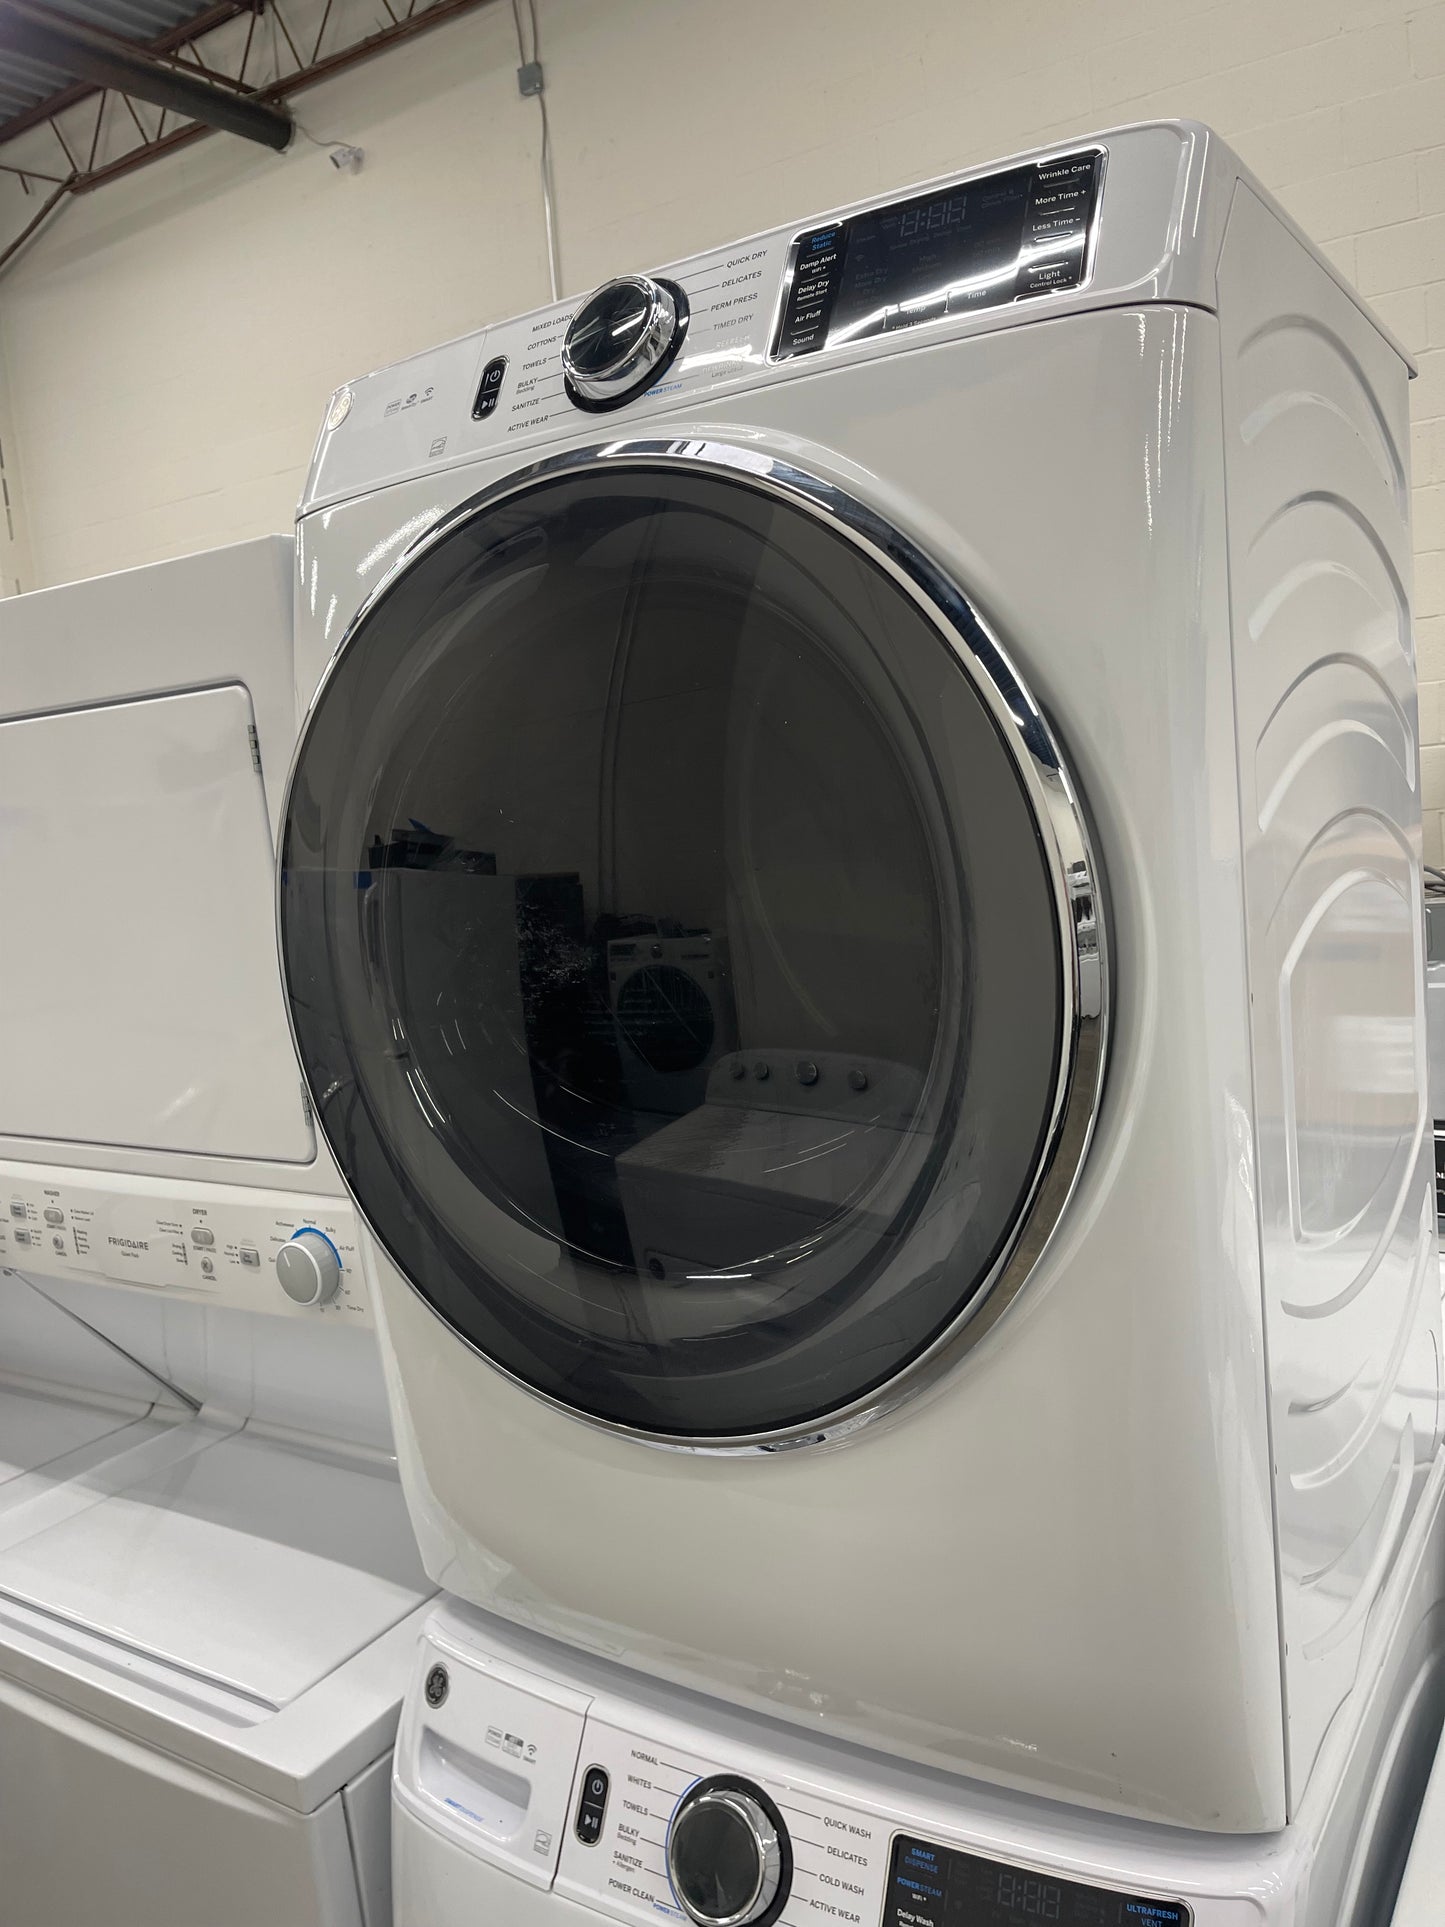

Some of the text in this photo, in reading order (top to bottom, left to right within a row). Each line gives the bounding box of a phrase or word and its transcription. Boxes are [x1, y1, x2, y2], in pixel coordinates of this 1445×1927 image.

[1038, 163, 1091, 181] Wrinkle Care
[1035, 194, 1056, 206] More
[1057, 190, 1079, 200] Time
[1032, 221, 1051, 232] Less
[1053, 217, 1074, 227] Time
[811, 231, 836, 244] Reduce
[811, 240, 832, 251] Static
[726, 249, 768, 269] QUICK DRY
[800, 253, 837, 271] Damp Alert
[721, 270, 762, 288] DELICATES
[1039, 270, 1061, 280] Light
[798, 280, 830, 294] Delay Dry
[710, 292, 758, 312] PERM PRESS
[532, 314, 574, 333] MIXED LOADS
[713, 313, 754, 331] TIMED DRY
[795, 309, 822, 323] Air Fluff
[527, 335, 557, 351] COTTONS
[792, 333, 815, 345] Sound
[522, 357, 547, 371] TOWELS
[517, 377, 538, 389] BULKY
[511, 398, 540, 412] SANITIZE
[507, 414, 549, 433] ACTIVE WEAR
[107, 1236, 149, 1251] FRIGIDAIRE
[630, 1749, 659, 1766] NORMAL
[627, 1774, 652, 1790] WHITES
[623, 1800, 649, 1816] TOWELS
[617, 1823, 641, 1838] BULKY
[823, 1816, 872, 1839] QUICK WASH
[613, 1850, 643, 1869] SANITIZE
[826, 1845, 868, 1867] DELICATES
[911, 1847, 936, 1862] SMART
[607, 1878, 655, 1903] POWER CLEAN
[819, 1873, 865, 1896] COLD WASH
[809, 1899, 861, 1924] ACTIVE WEAR
[896, 1908, 916, 1923] Delay
[915, 1914, 934, 1927] Wash
[1126, 1903, 1179, 1921] ULTRAFRESH
